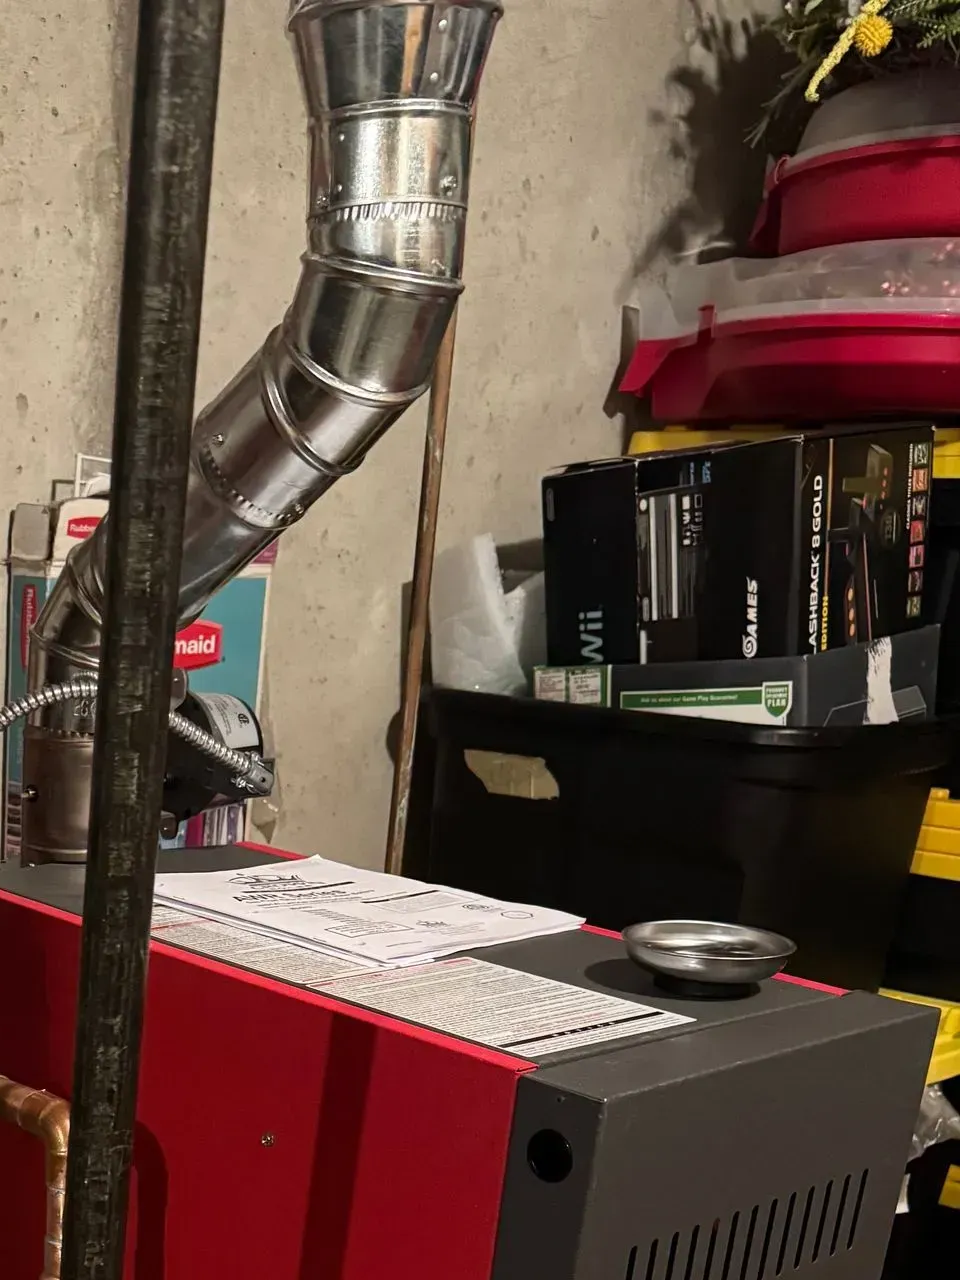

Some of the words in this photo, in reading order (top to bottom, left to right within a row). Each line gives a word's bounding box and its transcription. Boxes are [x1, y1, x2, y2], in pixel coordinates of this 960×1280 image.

[812, 475, 823, 530] GOLD
[811, 534, 821, 547] 8
[578, 610, 603, 664] Wii
[820, 595, 829, 651] EDITION
[767, 698, 786, 707] PLAN
